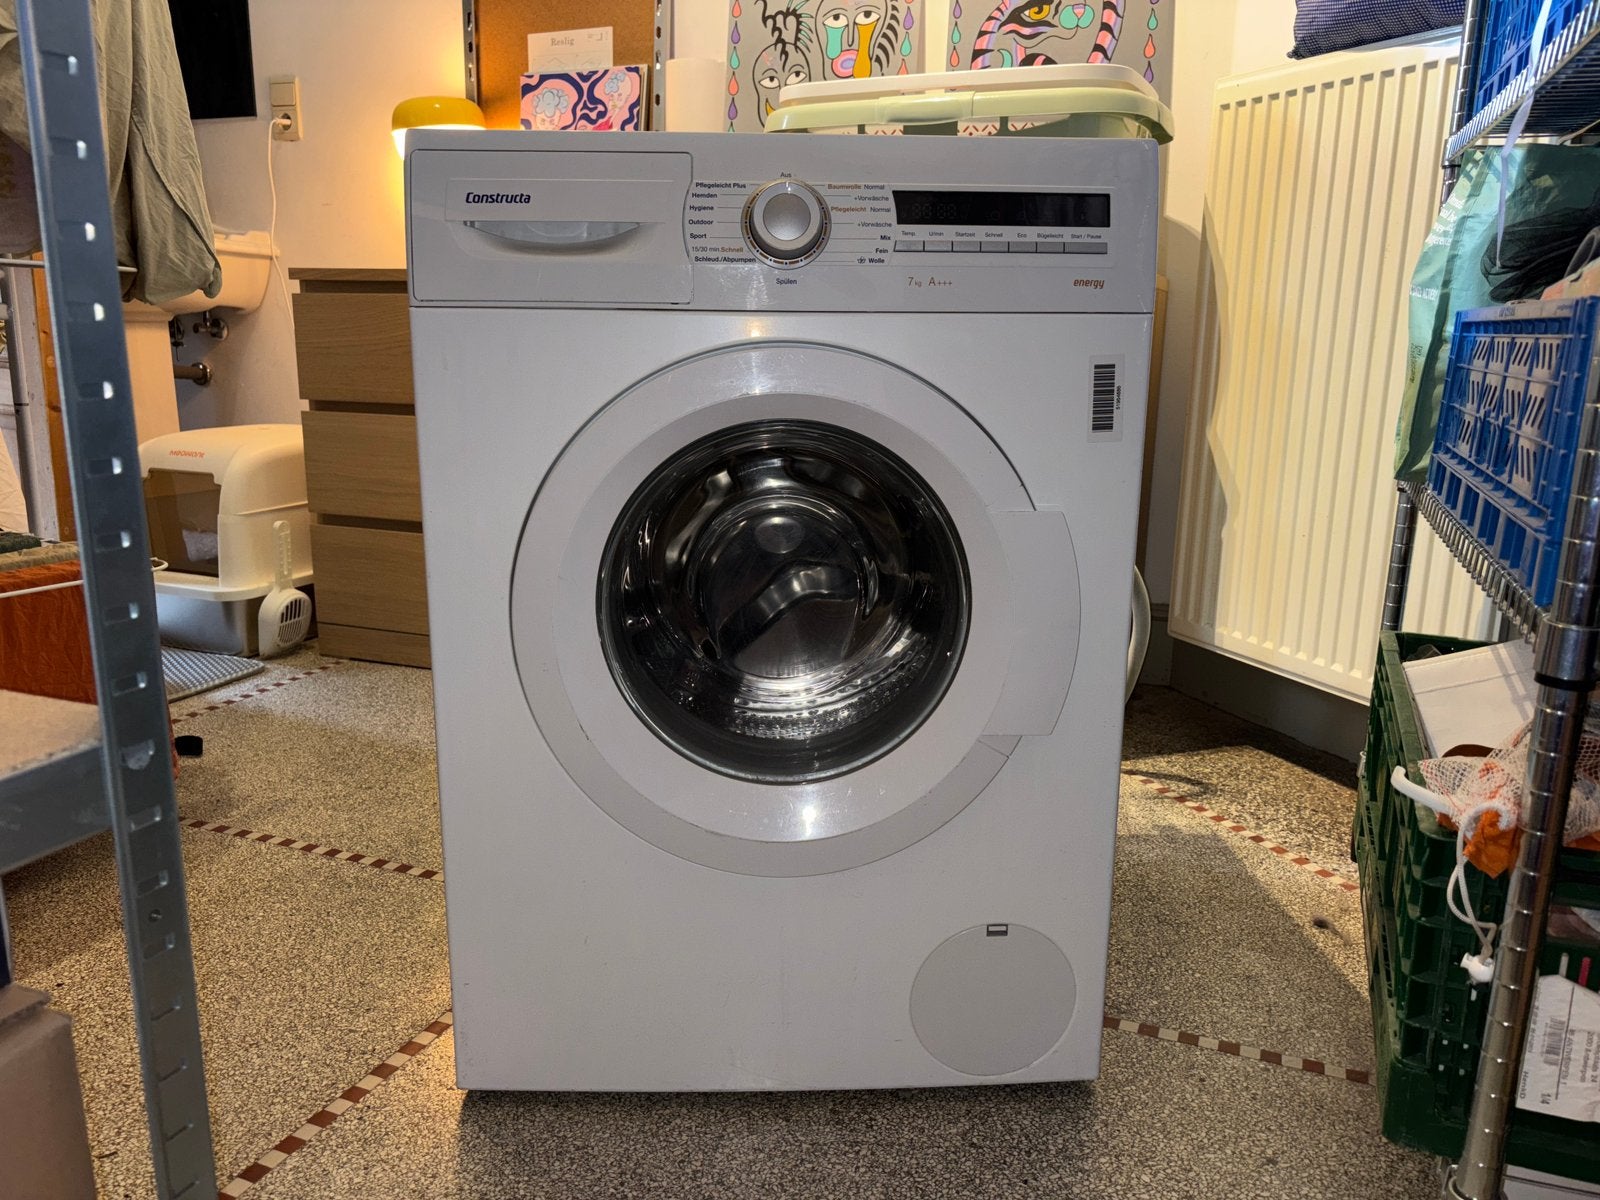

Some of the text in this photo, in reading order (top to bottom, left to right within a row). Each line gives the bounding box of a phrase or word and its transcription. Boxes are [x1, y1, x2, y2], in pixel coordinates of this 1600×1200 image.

[465, 192, 531, 204] Constructa
[908, 276, 952, 288] 7 kg A+++
[1073, 278, 1105, 290] energy
[1540, 1092, 1552, 1105] 1/4
